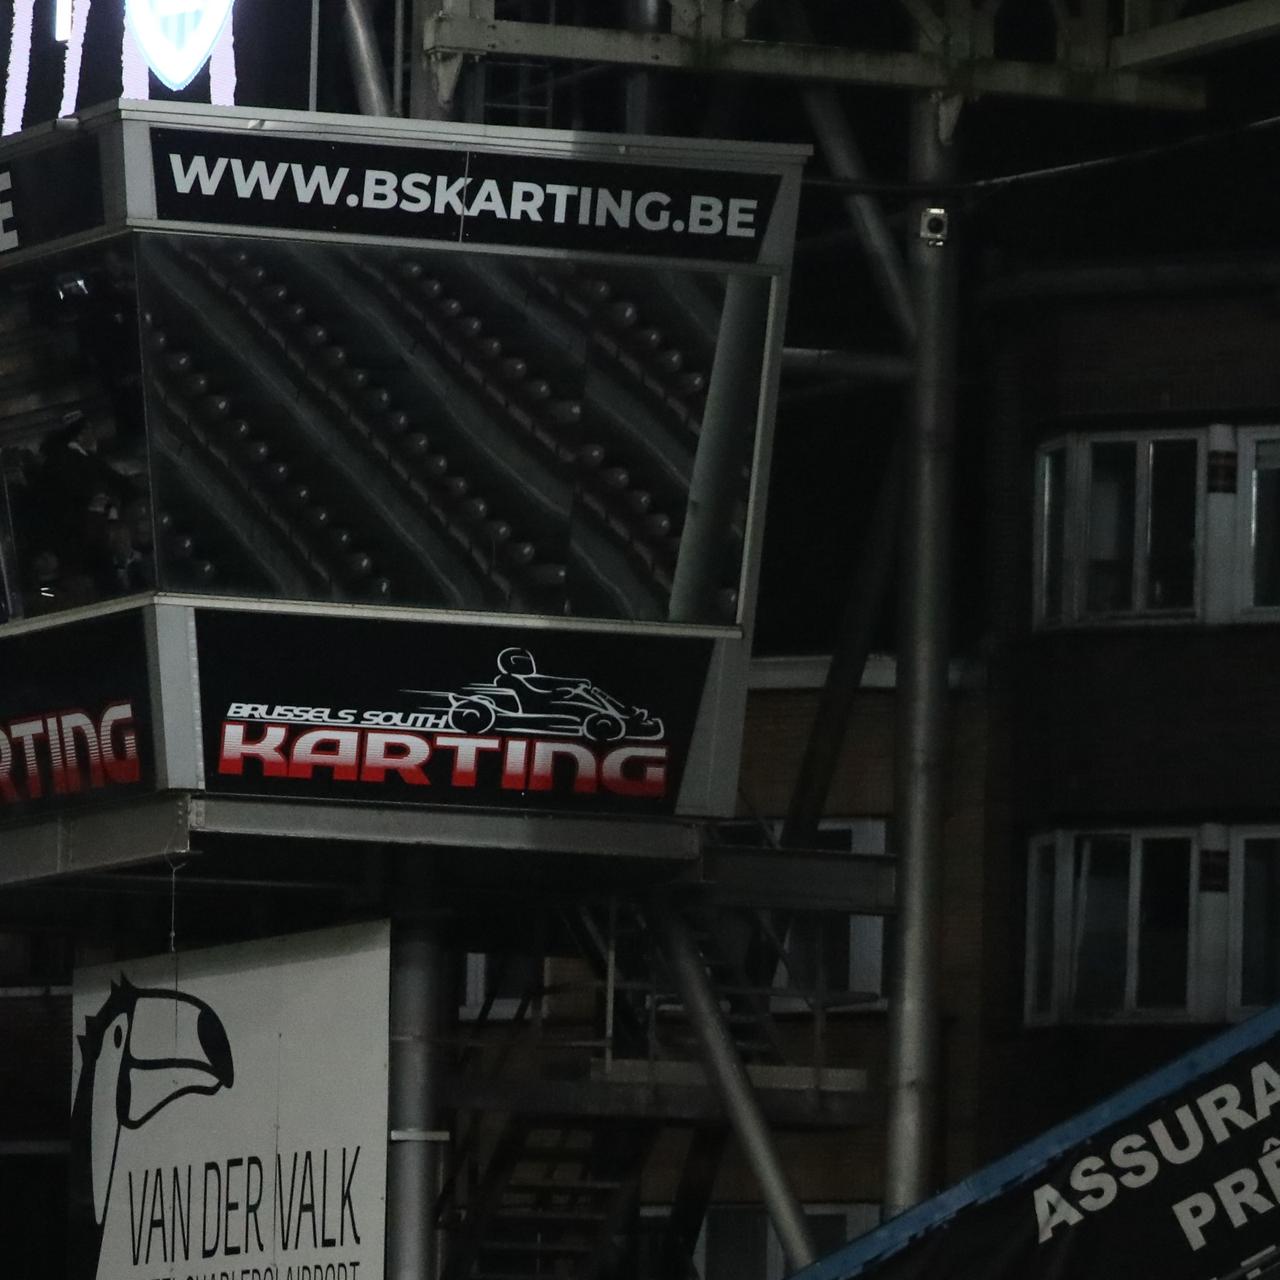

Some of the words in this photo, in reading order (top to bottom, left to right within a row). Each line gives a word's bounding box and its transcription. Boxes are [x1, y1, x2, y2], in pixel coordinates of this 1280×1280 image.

[168, 152, 759, 238] WWW.BSKARTING.BE
[226, 702, 357, 723] BRUSSELS
[361, 711, 449, 729] SOUTH
[216, 720, 669, 799] KARTING
[127, 1164, 193, 1267] VAN
[202, 1156, 264, 1261] DER
[276, 1145, 361, 1252] VALK
